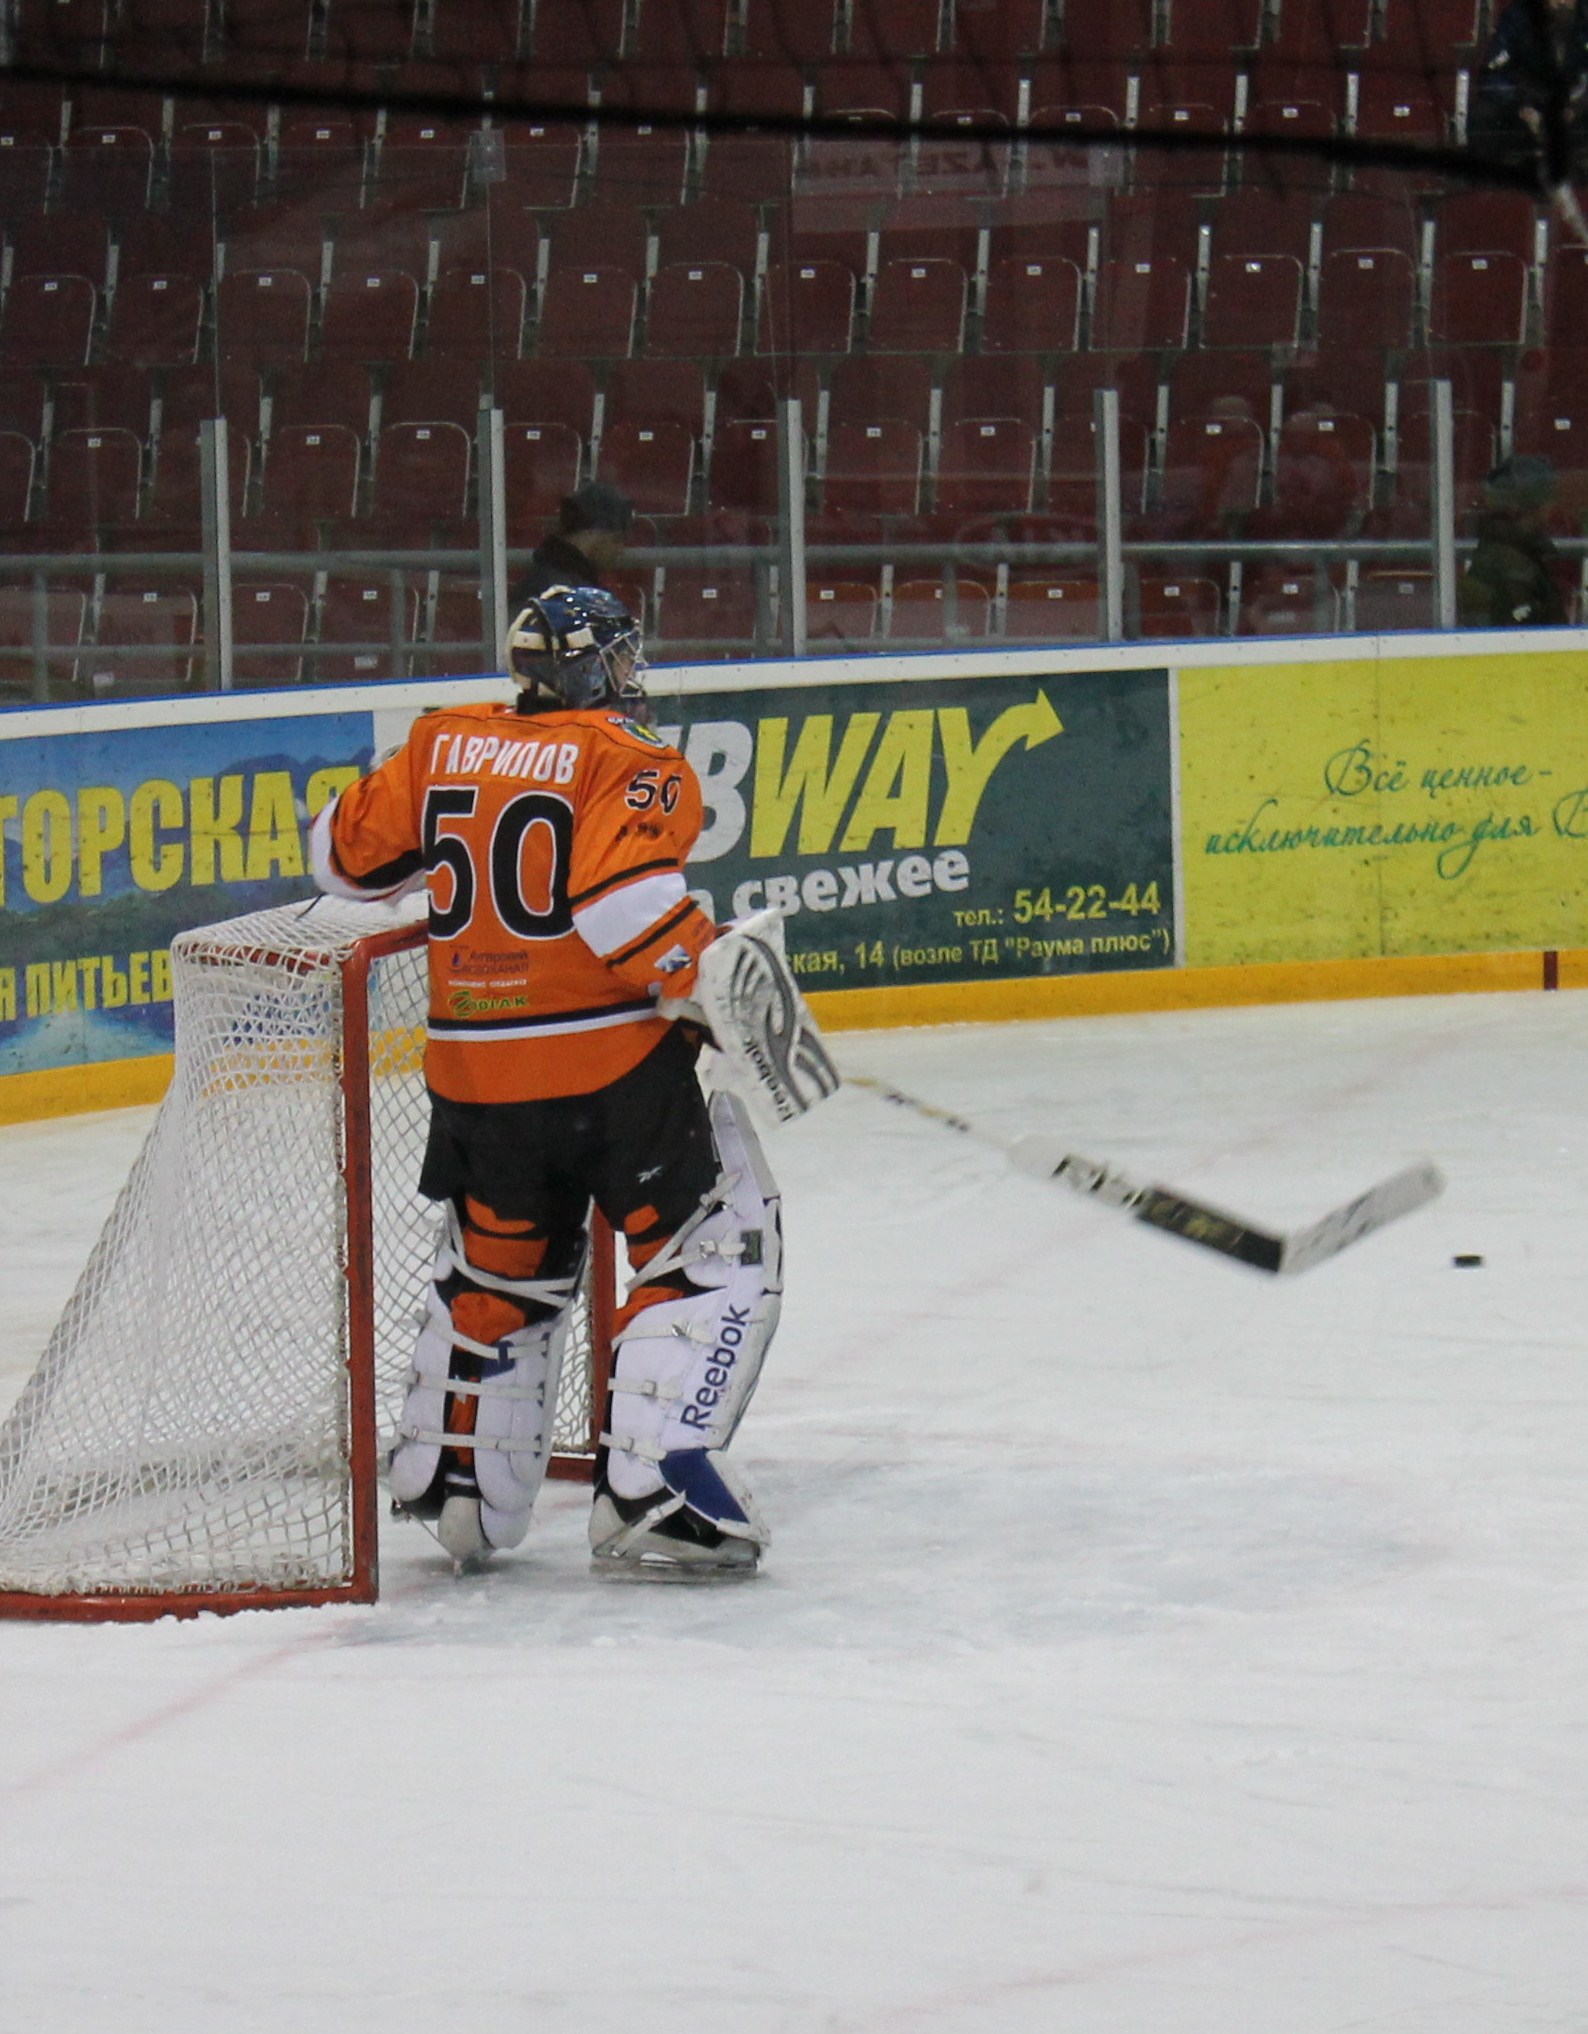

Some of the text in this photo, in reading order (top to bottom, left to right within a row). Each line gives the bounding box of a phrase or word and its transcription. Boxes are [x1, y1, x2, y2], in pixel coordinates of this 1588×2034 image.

[430, 733, 579, 784] ГАВРИЛОВ
[624, 768, 682, 816] 50
[657, 688, 1064, 864] BWAY
[1323, 738, 1409, 796] Всё
[421, 785, 575, 941] 50
[1205, 798, 1464, 856] исключительно
[1437, 812, 1541, 880] для
[733, 850, 970, 919] свежее
[953, 880, 1161, 927] тел.: 54-22-44
[854, 941, 884, 969] 14
[892, 945, 962, 971] (возле
[969, 938, 999, 966] ТД
[743, 1036, 794, 1122] Reebok
[680, 1304, 750, 1431] Reebok
